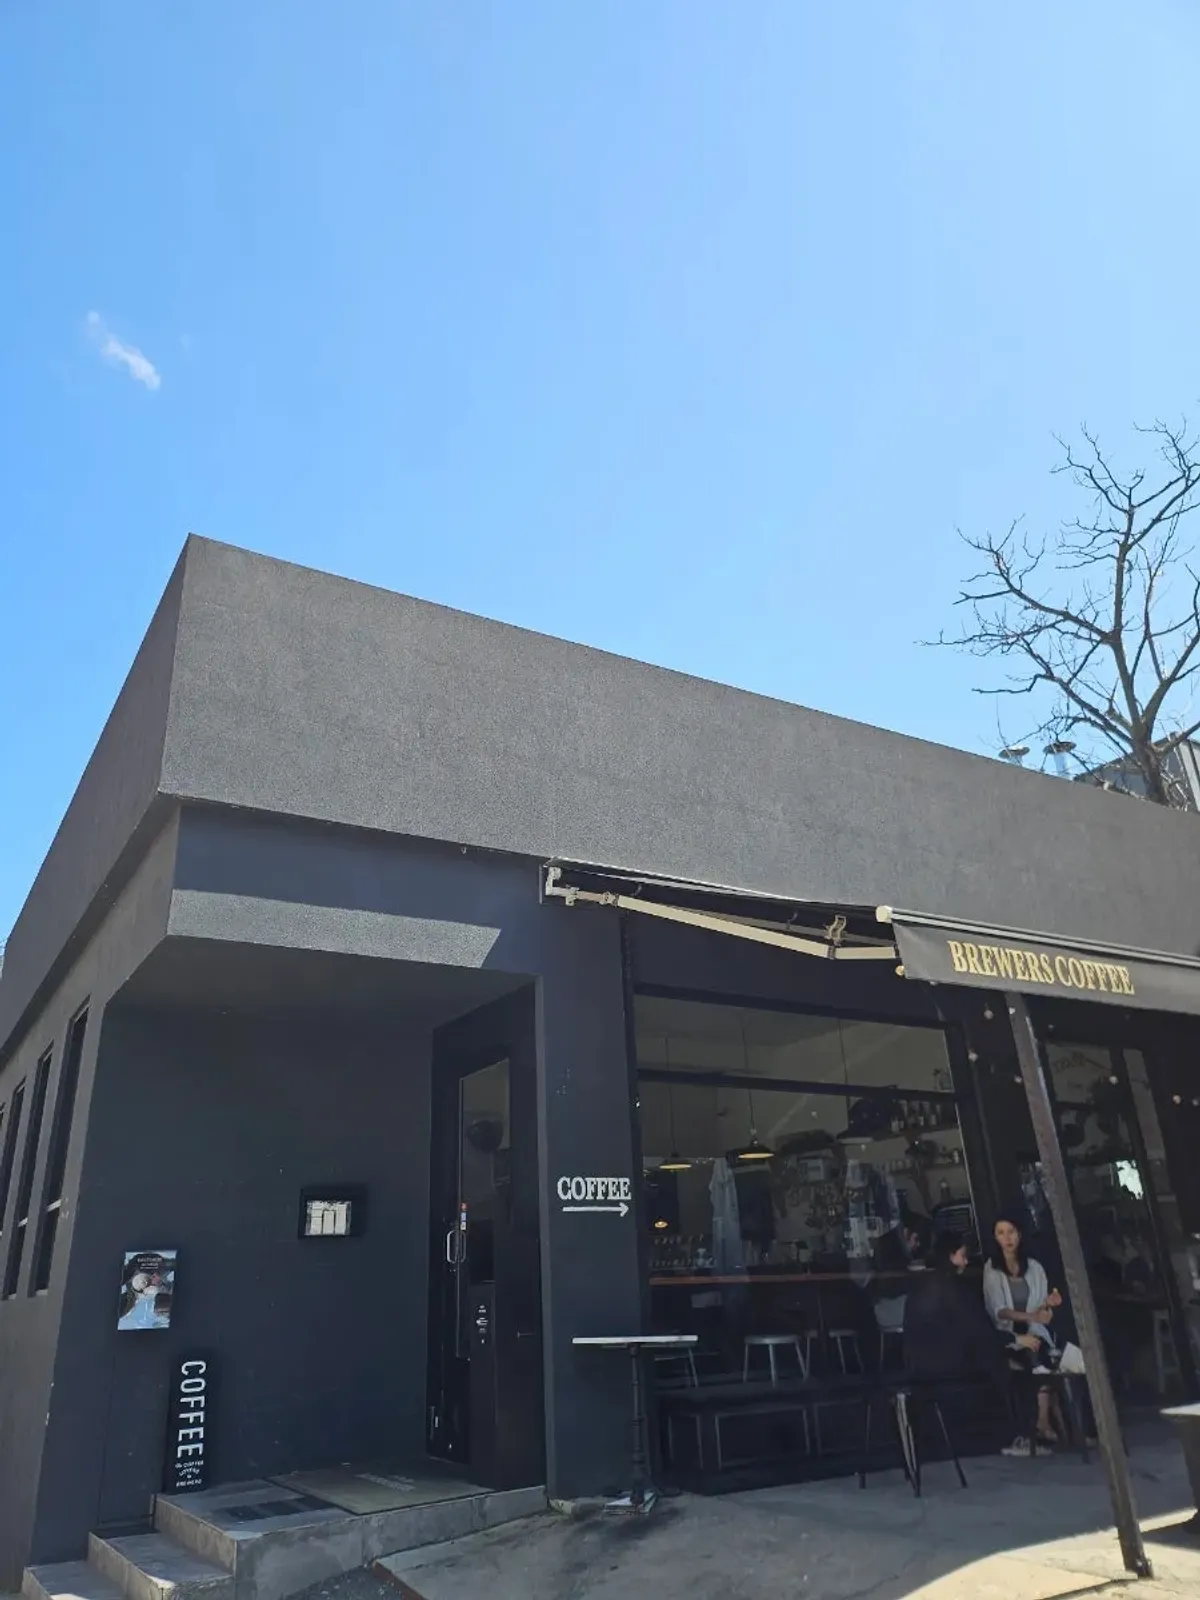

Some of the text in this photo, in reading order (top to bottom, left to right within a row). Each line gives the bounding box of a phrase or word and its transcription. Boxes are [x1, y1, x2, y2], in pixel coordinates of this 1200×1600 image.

[947, 940, 1135, 996] BREWERS COFFEE
[557, 1176, 632, 1200] COFFEE
[177, 1360, 207, 1458] COFFEE
